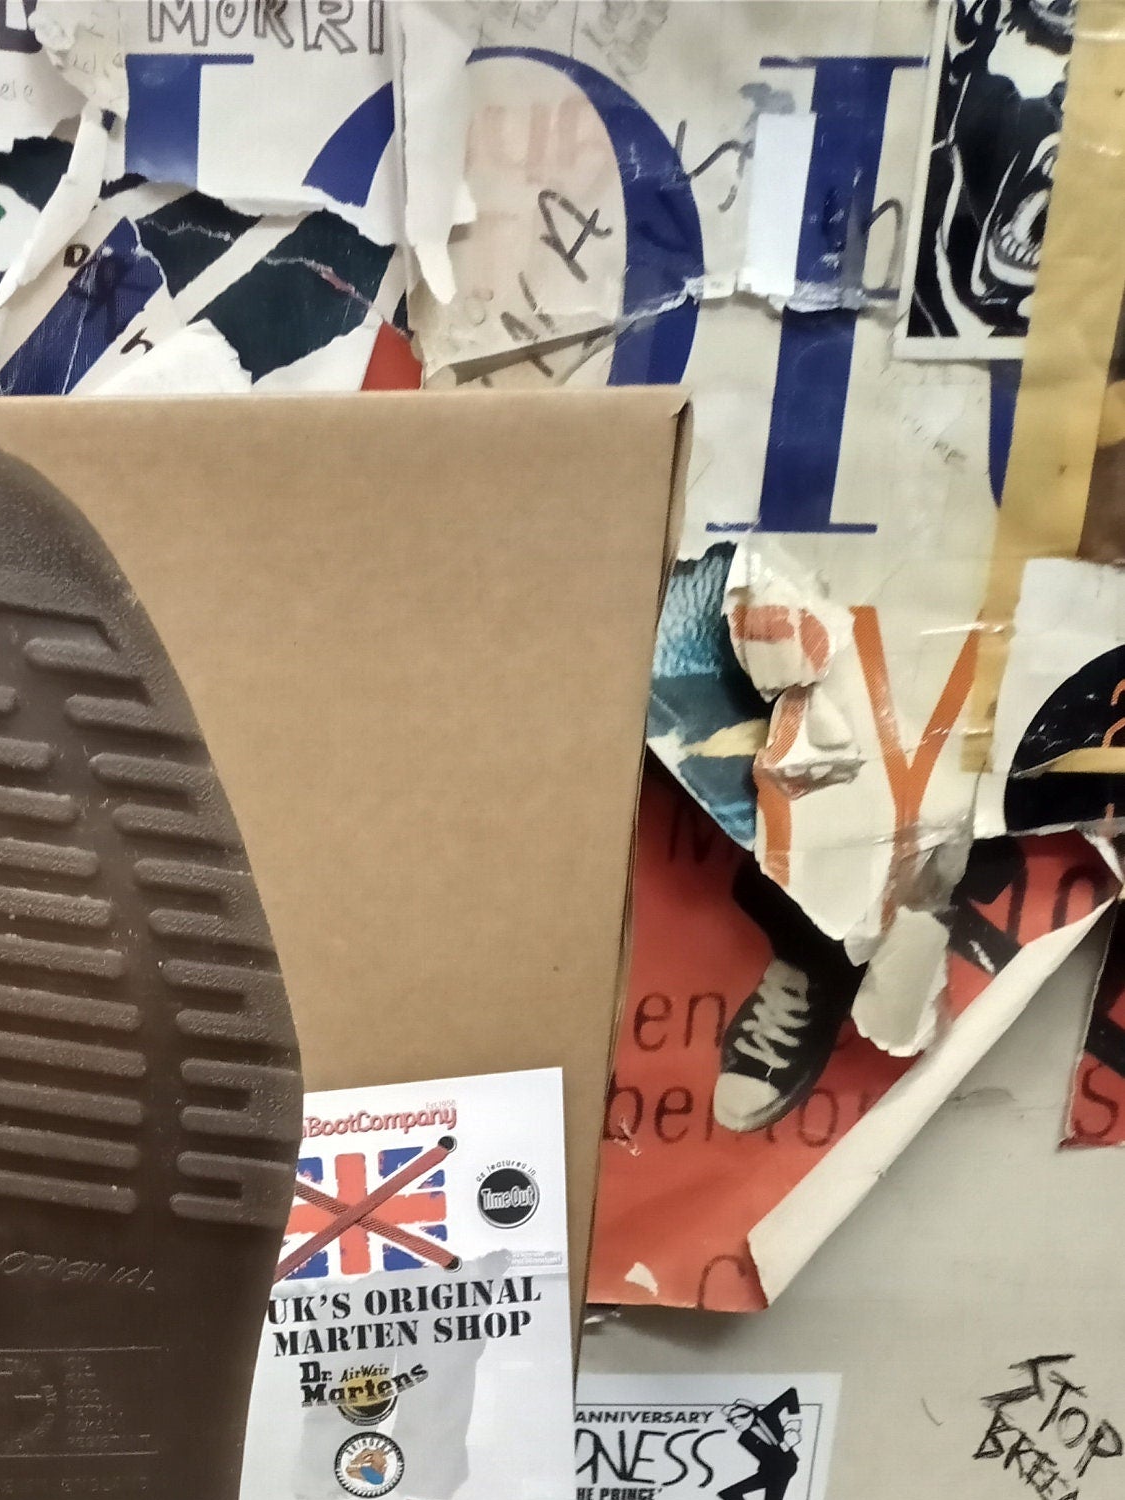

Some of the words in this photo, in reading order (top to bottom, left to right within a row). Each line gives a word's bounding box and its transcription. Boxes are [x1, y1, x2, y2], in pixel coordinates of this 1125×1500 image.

[364, 1275, 542, 1315] ORIGINAL
[272, 1318, 419, 1358] MARTEN
[433, 1309, 532, 1345] SHOP
[299, 1361, 333, 1384] Dr.
[300, 1363, 429, 1408] Martens
[575, 1411, 714, 1424] ANNIVERSARY
